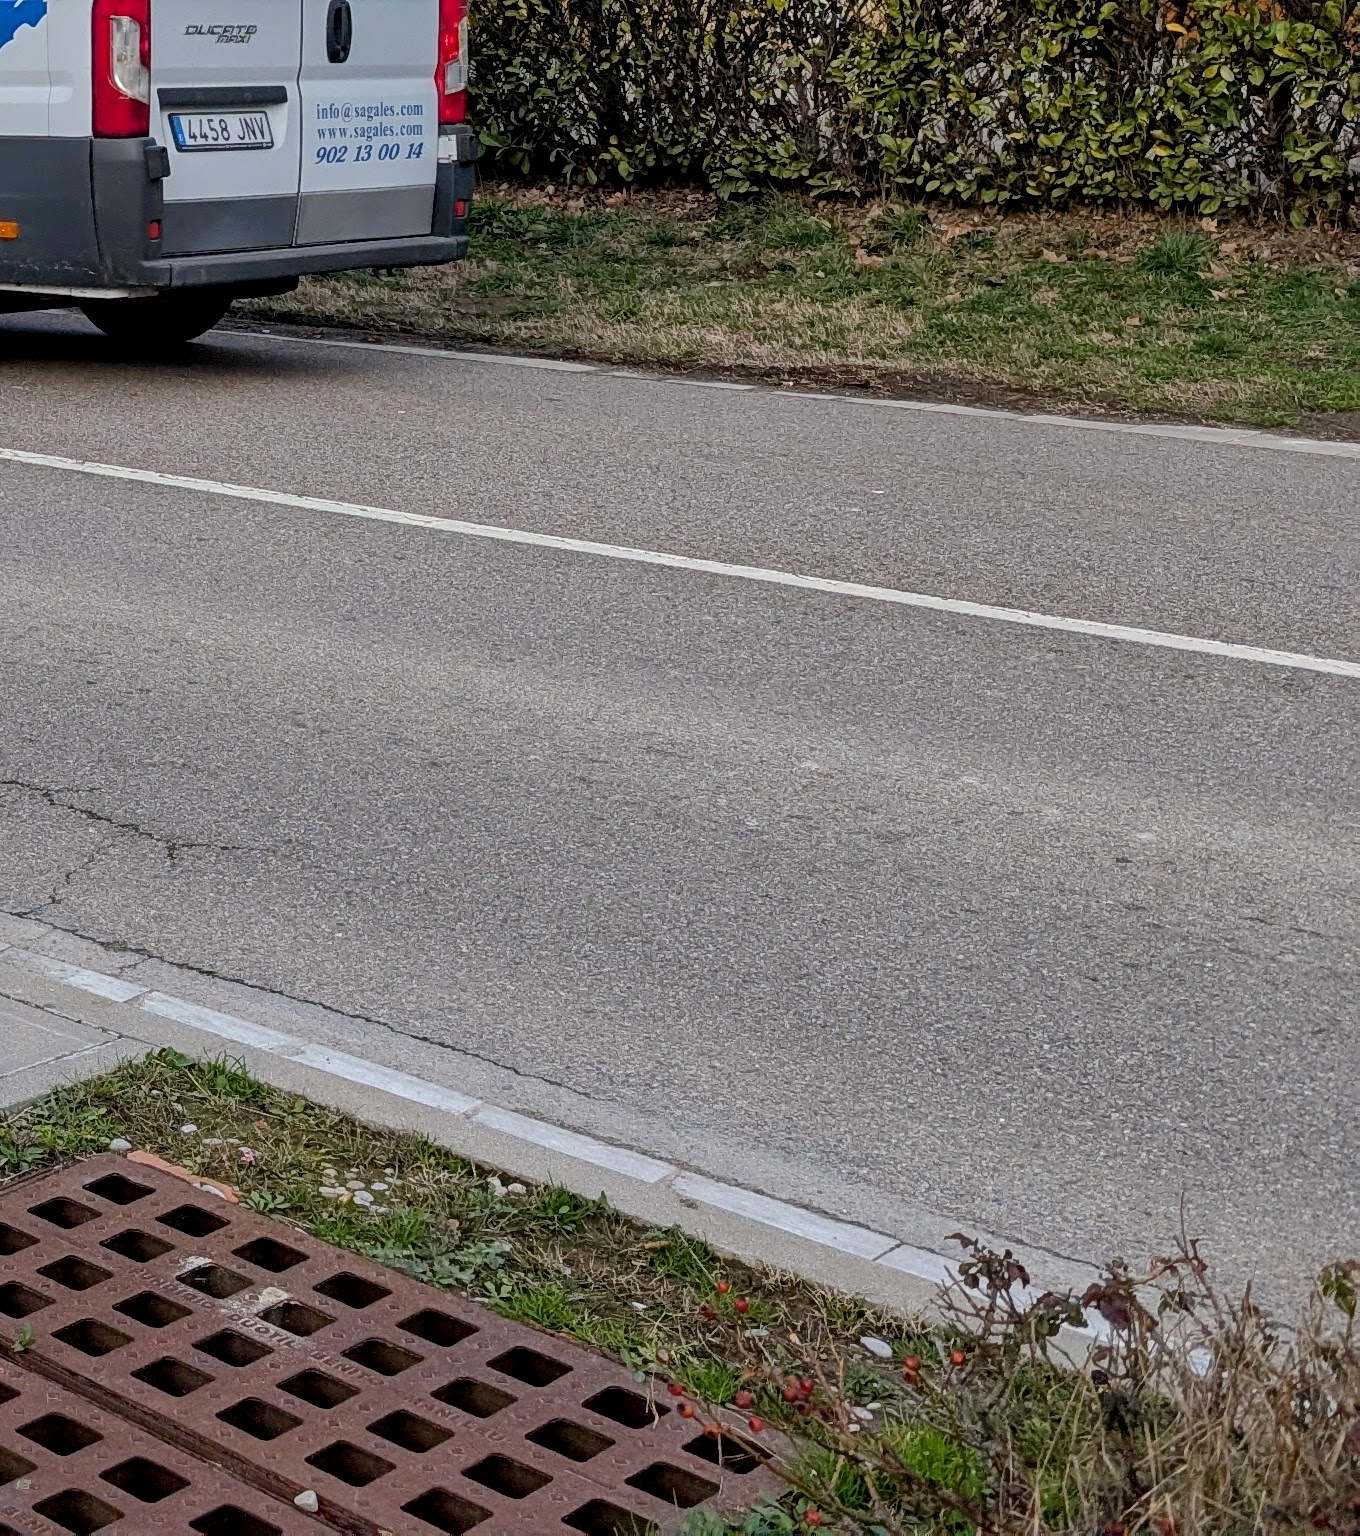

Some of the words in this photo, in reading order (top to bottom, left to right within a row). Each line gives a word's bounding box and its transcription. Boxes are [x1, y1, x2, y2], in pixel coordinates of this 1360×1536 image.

[184, 25, 257, 35] DUCATO
[215, 35, 250, 43] MAXI
[316, 102, 423, 122] info@sagales.com
[188, 119, 230, 142] 4458
[237, 117, 265, 140] JNV
[317, 122, 423, 142] www.sagales.com
[315, 146, 348, 164] 902
[353, 145, 373, 162] 13
[378, 143, 400, 160] 00
[405, 142, 424, 159] 14
[310, 1350, 384, 1386] BENITO
